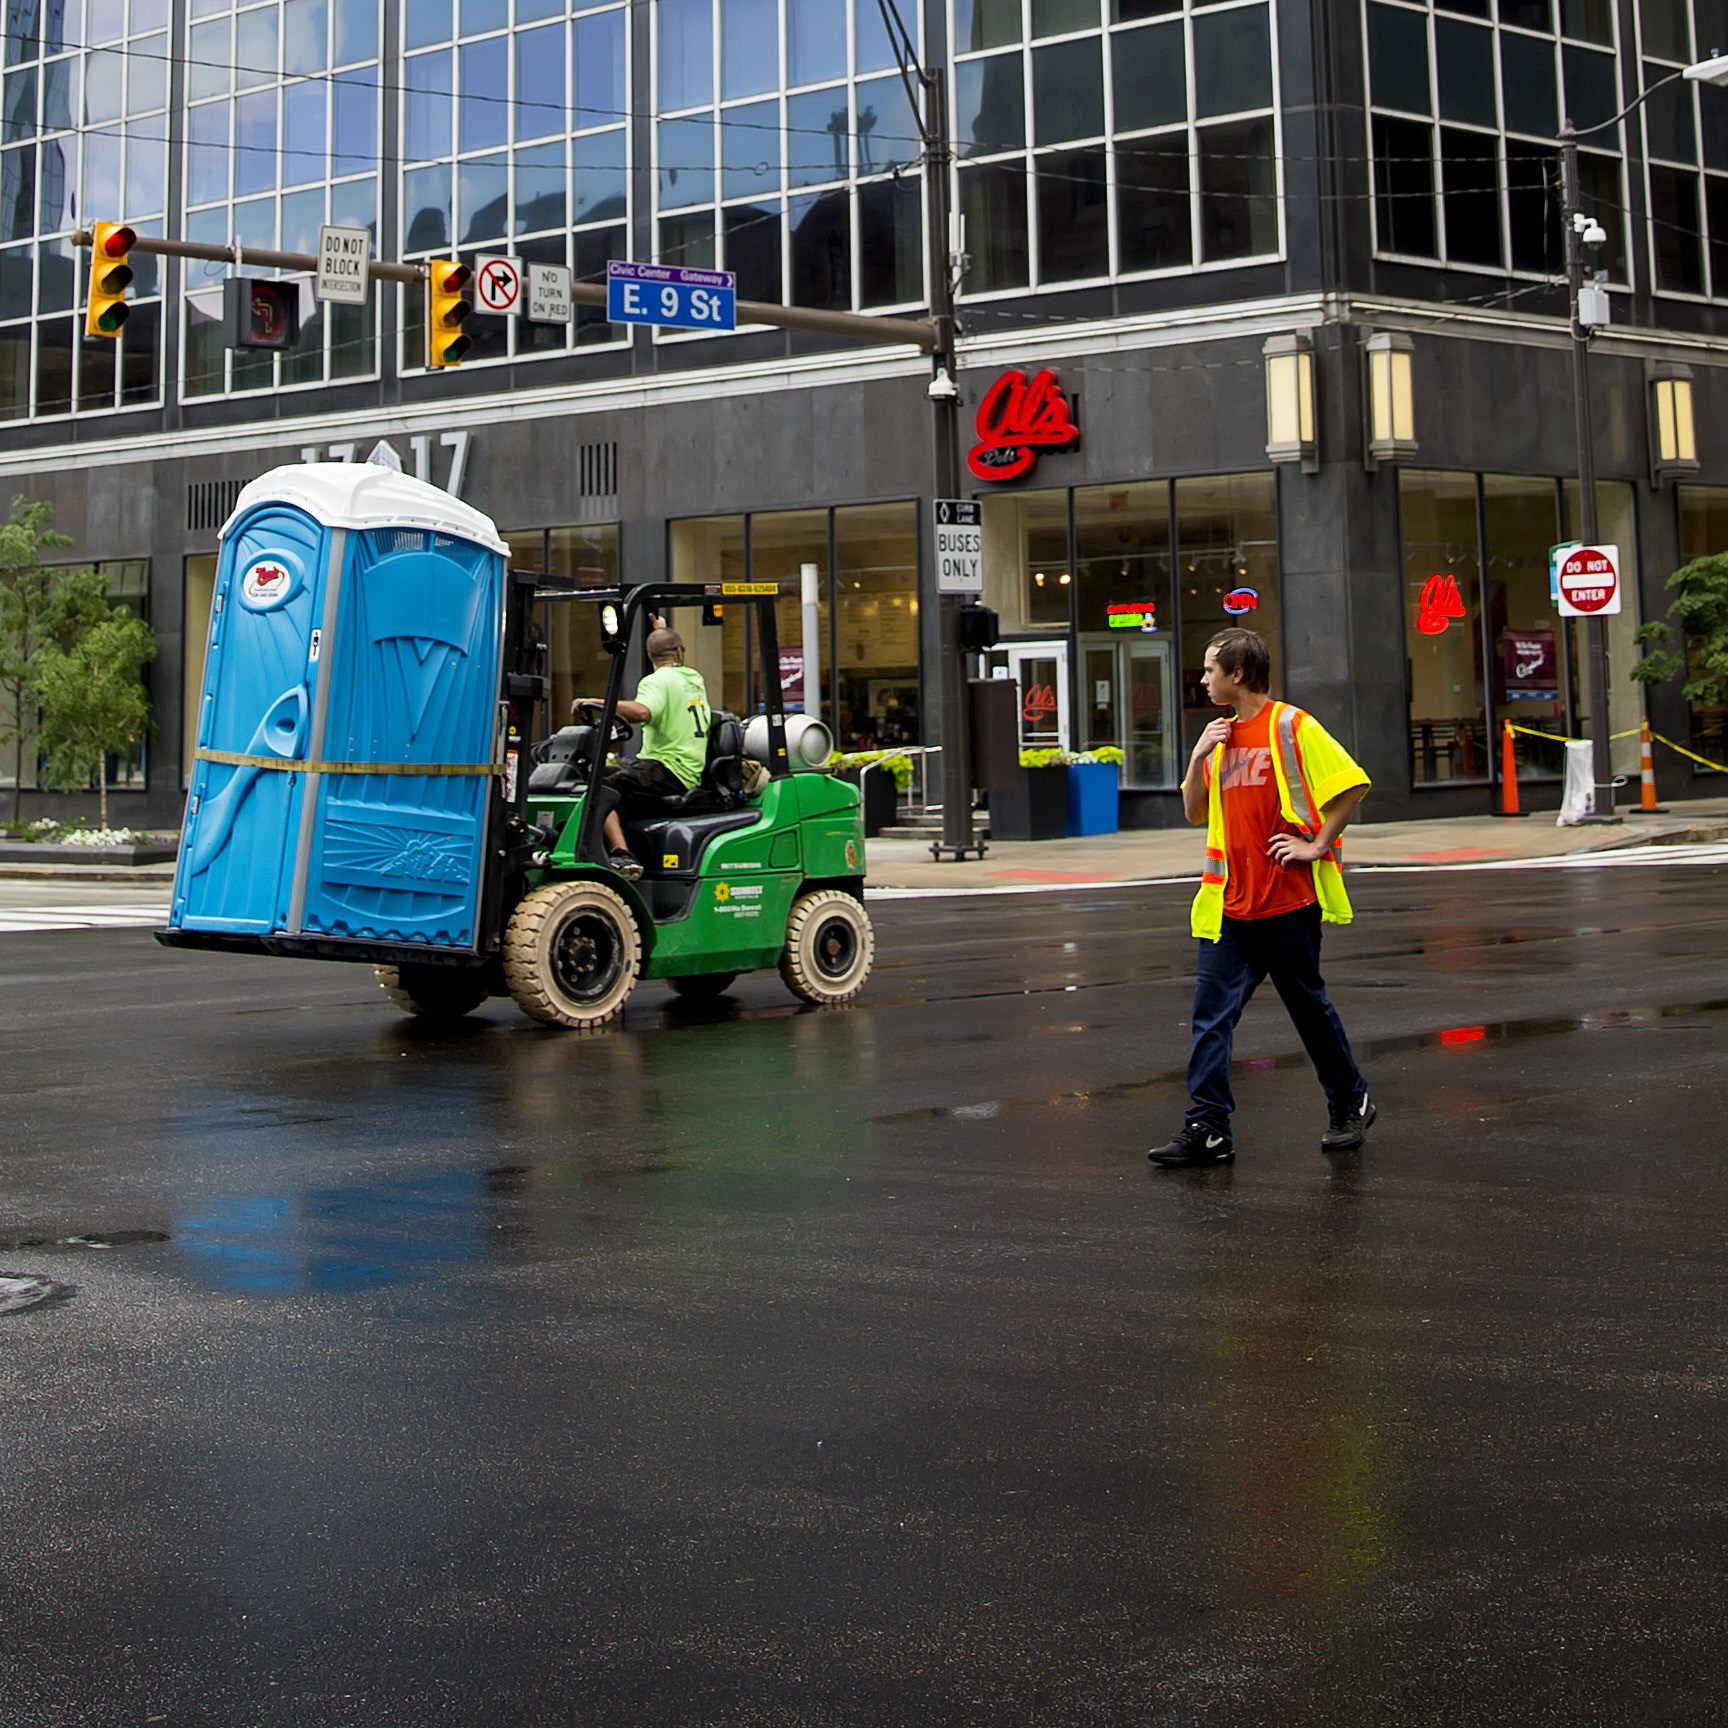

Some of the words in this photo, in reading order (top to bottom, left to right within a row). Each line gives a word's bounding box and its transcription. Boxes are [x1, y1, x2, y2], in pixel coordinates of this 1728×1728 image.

[325, 235, 340, 252] DO
[343, 237, 364, 255] NOT
[325, 257, 360, 276] BLOCK
[610, 263, 635, 277] Civic
[637, 266, 671, 279] Center
[680, 268, 722, 286] Gateway
[541, 271, 558, 283] NO
[538, 286, 563, 299] TURN
[532, 302, 546, 314] ON
[549, 303, 568, 317] RED
[623, 283, 647, 315] E.
[660, 287, 679, 318] 9
[690, 289, 721, 322] St
[939, 533, 980, 553] BUSES
[942, 558, 977, 577] ONLY
[1566, 560, 1582, 573] DO
[1587, 558, 1608, 572] NOT
[1223, 593, 1257, 609] OPEN
[1571, 588, 1606, 602] ENTER
